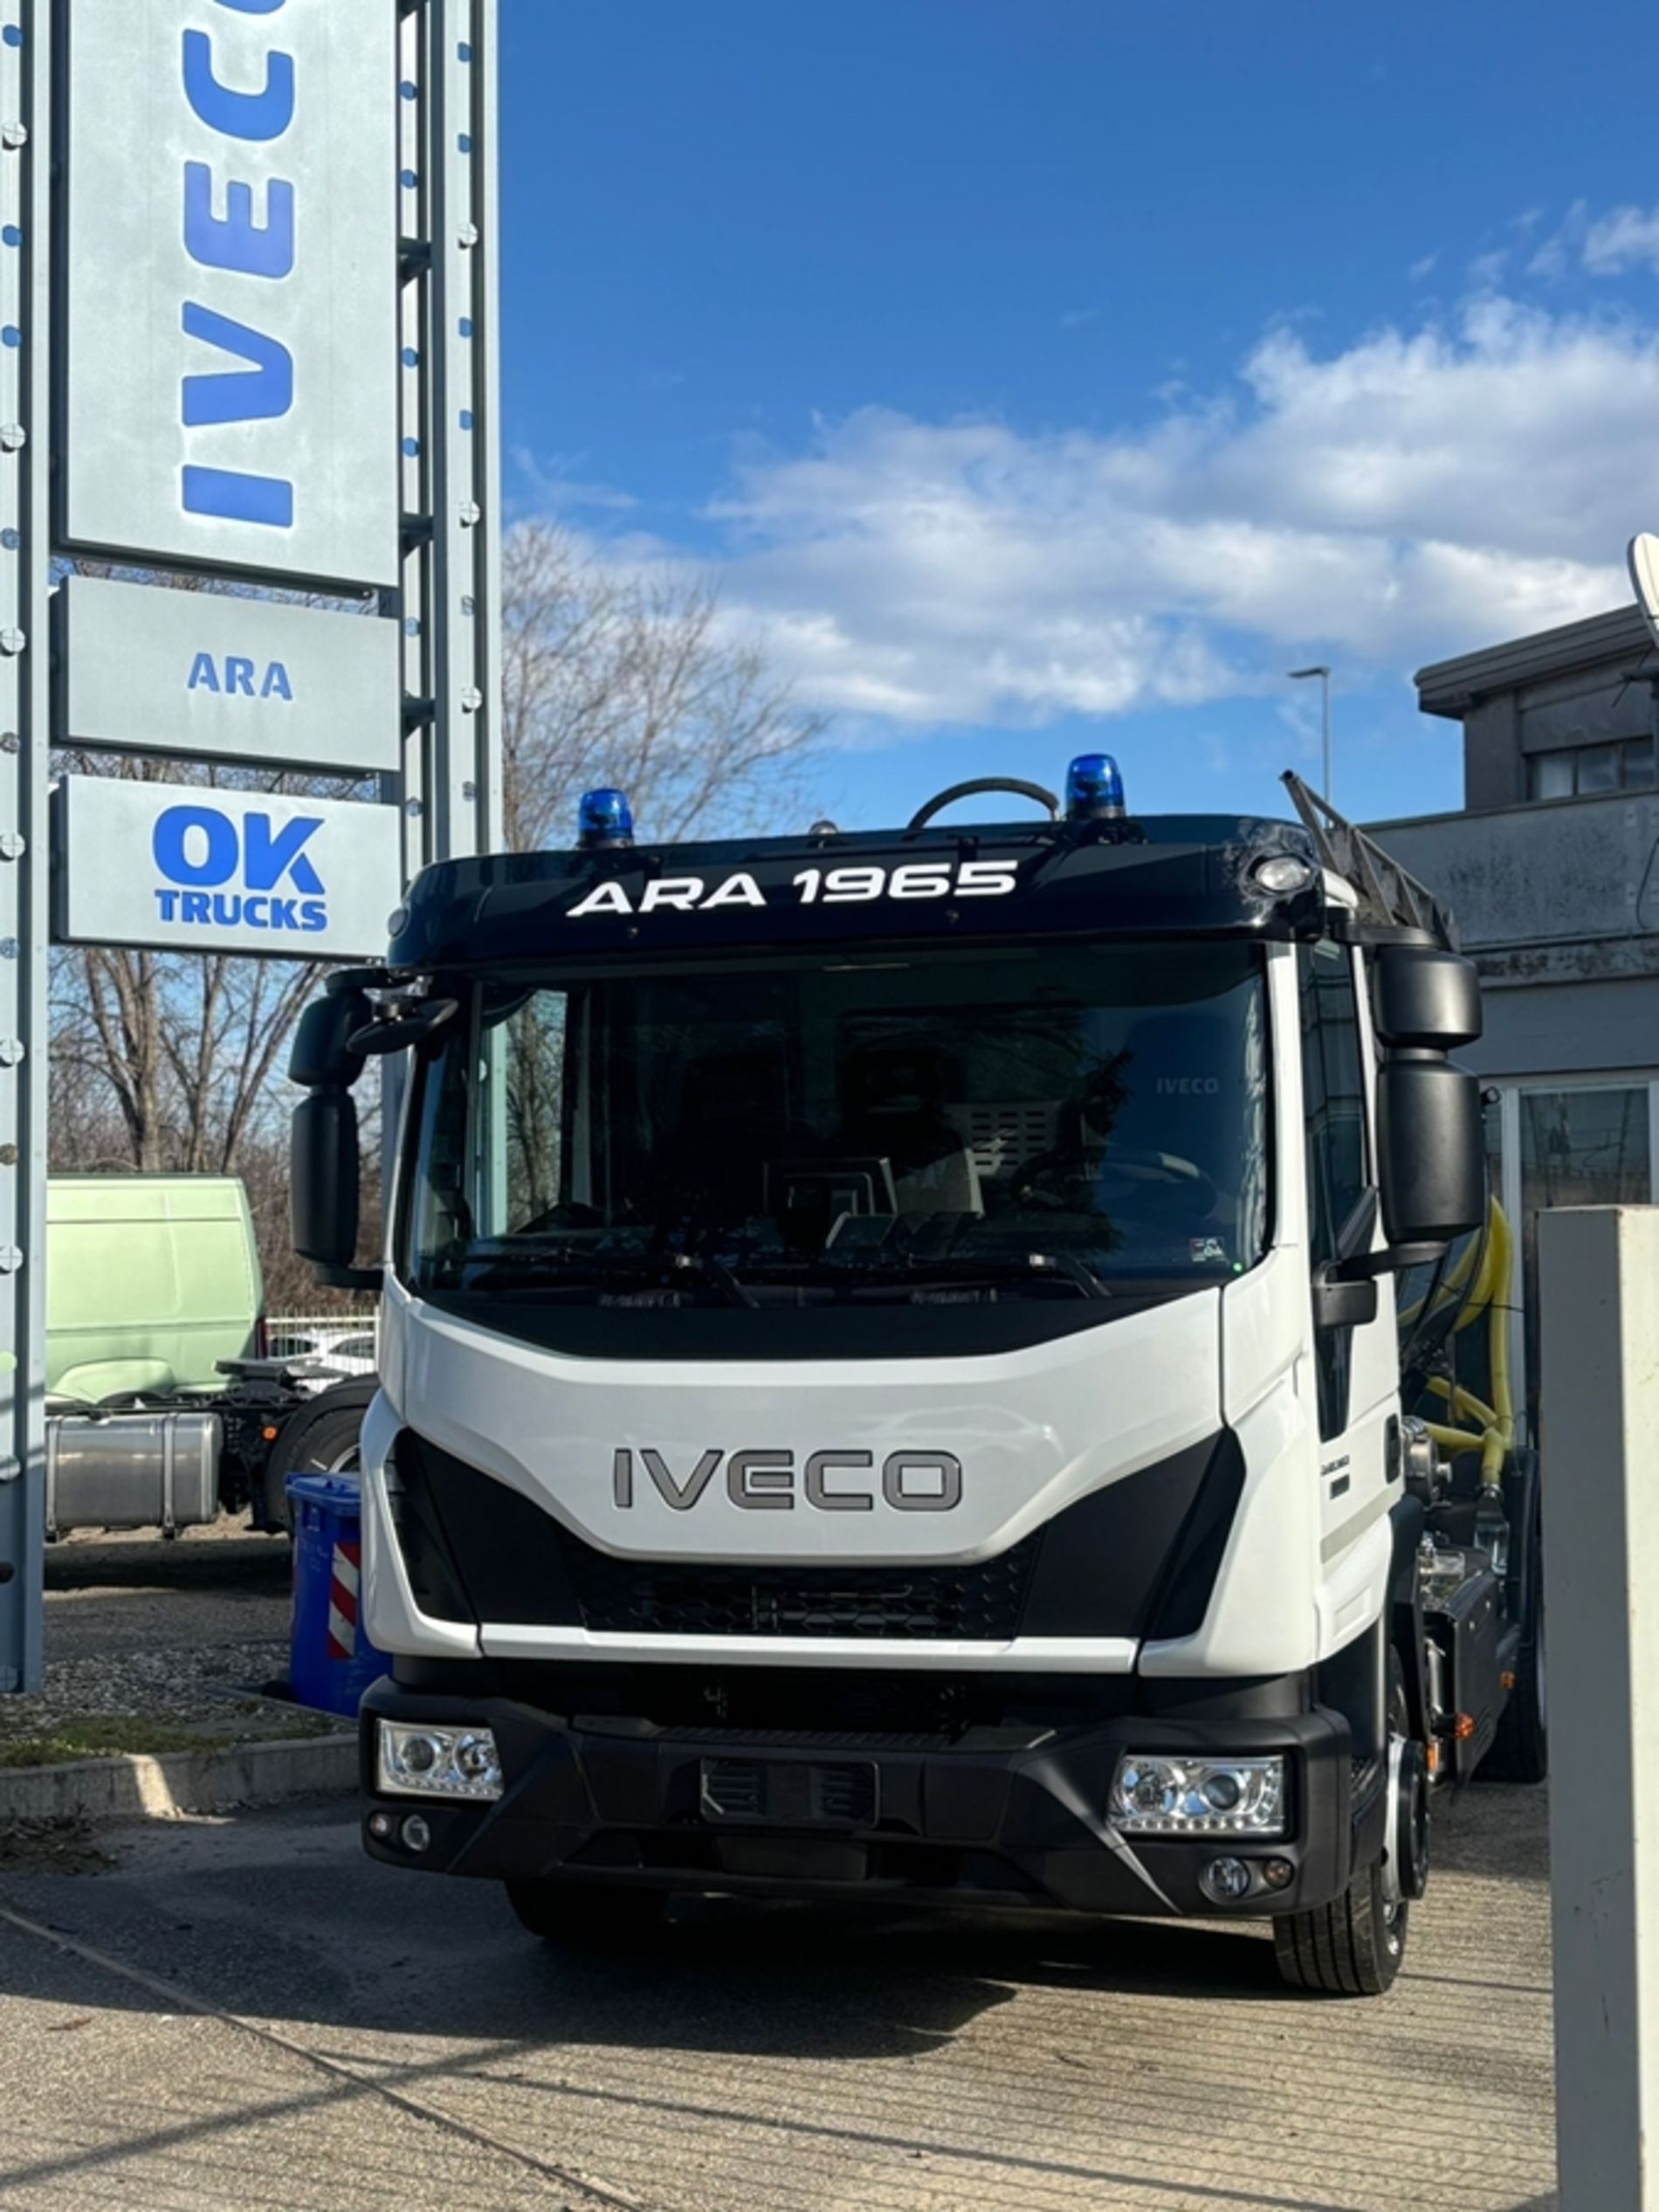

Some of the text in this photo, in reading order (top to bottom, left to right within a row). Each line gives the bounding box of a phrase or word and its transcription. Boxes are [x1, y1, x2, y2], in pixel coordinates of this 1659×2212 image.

[182, 0, 293, 527] IVEC
[188, 652, 293, 700] ARA
[153, 805, 326, 895] OK
[155, 889, 327, 931] TRUCKS
[565, 859, 1019, 917] ARA 1965
[1157, 1078, 1219, 1094] IVECO
[613, 1448, 963, 1511] IVECO
